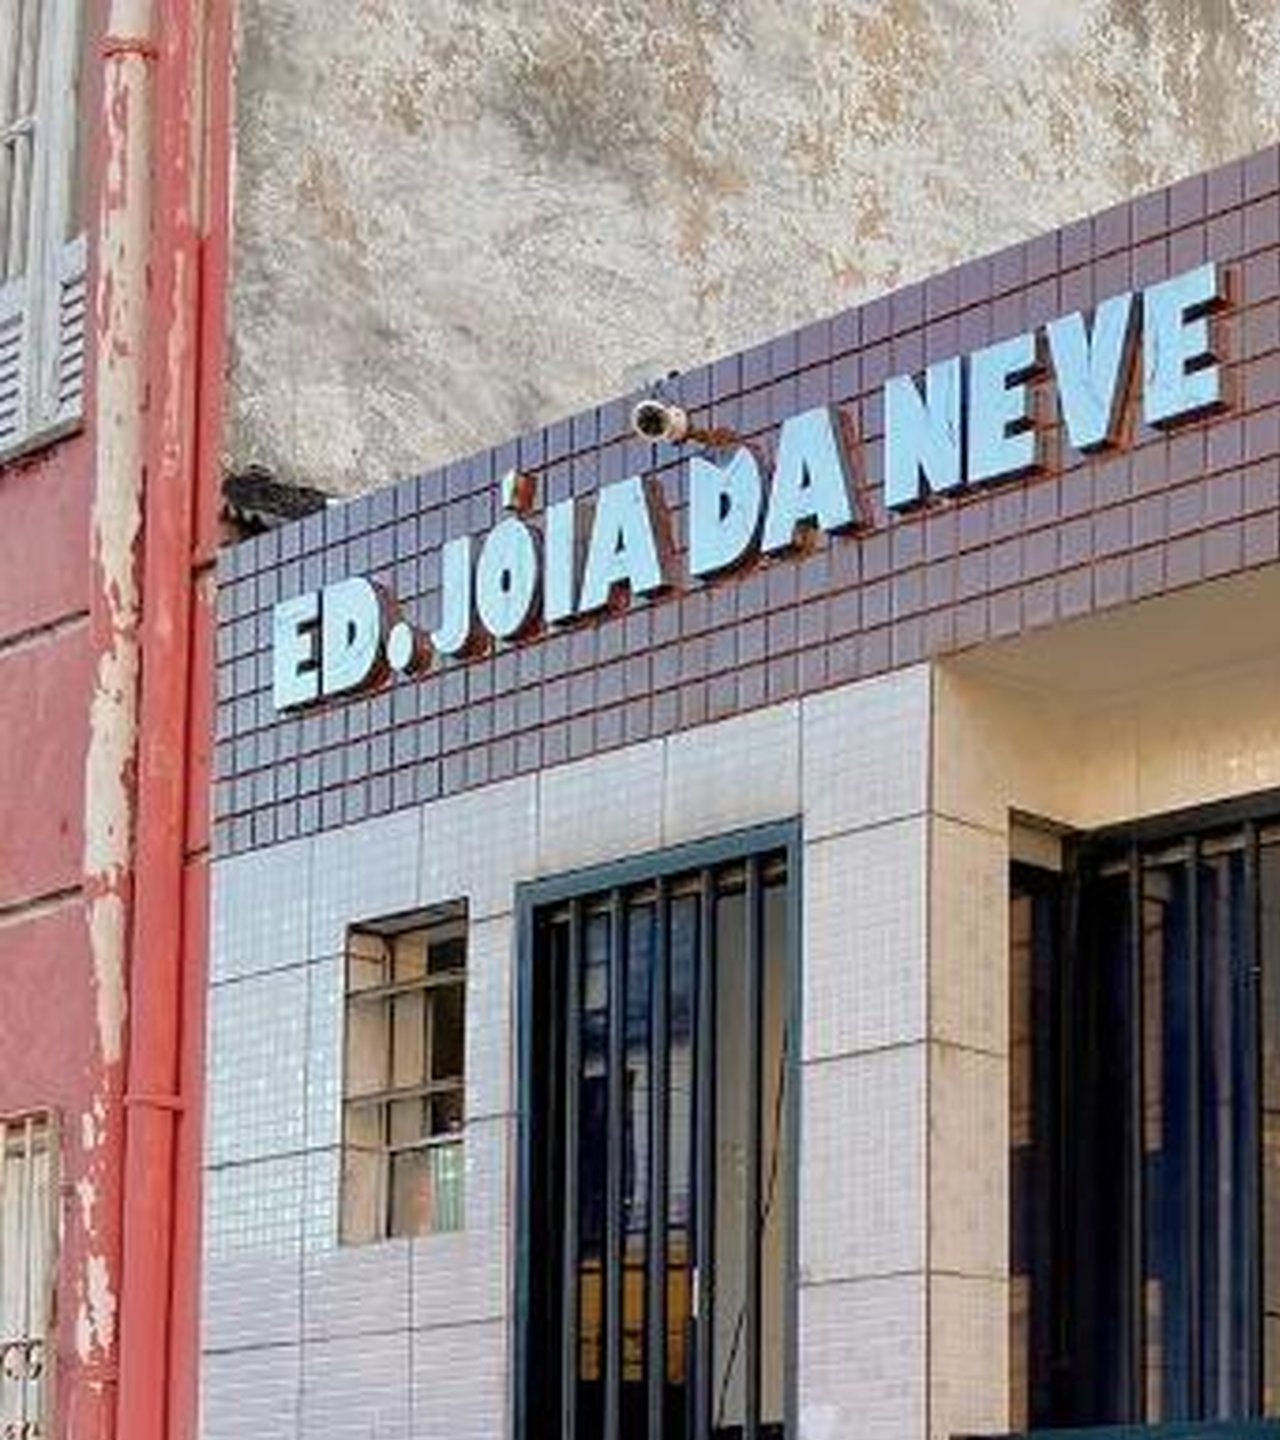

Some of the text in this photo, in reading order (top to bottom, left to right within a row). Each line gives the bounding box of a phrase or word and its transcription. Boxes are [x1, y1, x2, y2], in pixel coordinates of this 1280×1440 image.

[273, 577, 413, 710] ED.
[434, 470, 664, 657] JÓIA
[689, 408, 853, 576] DA
[884, 261, 1225, 508] NEVE
